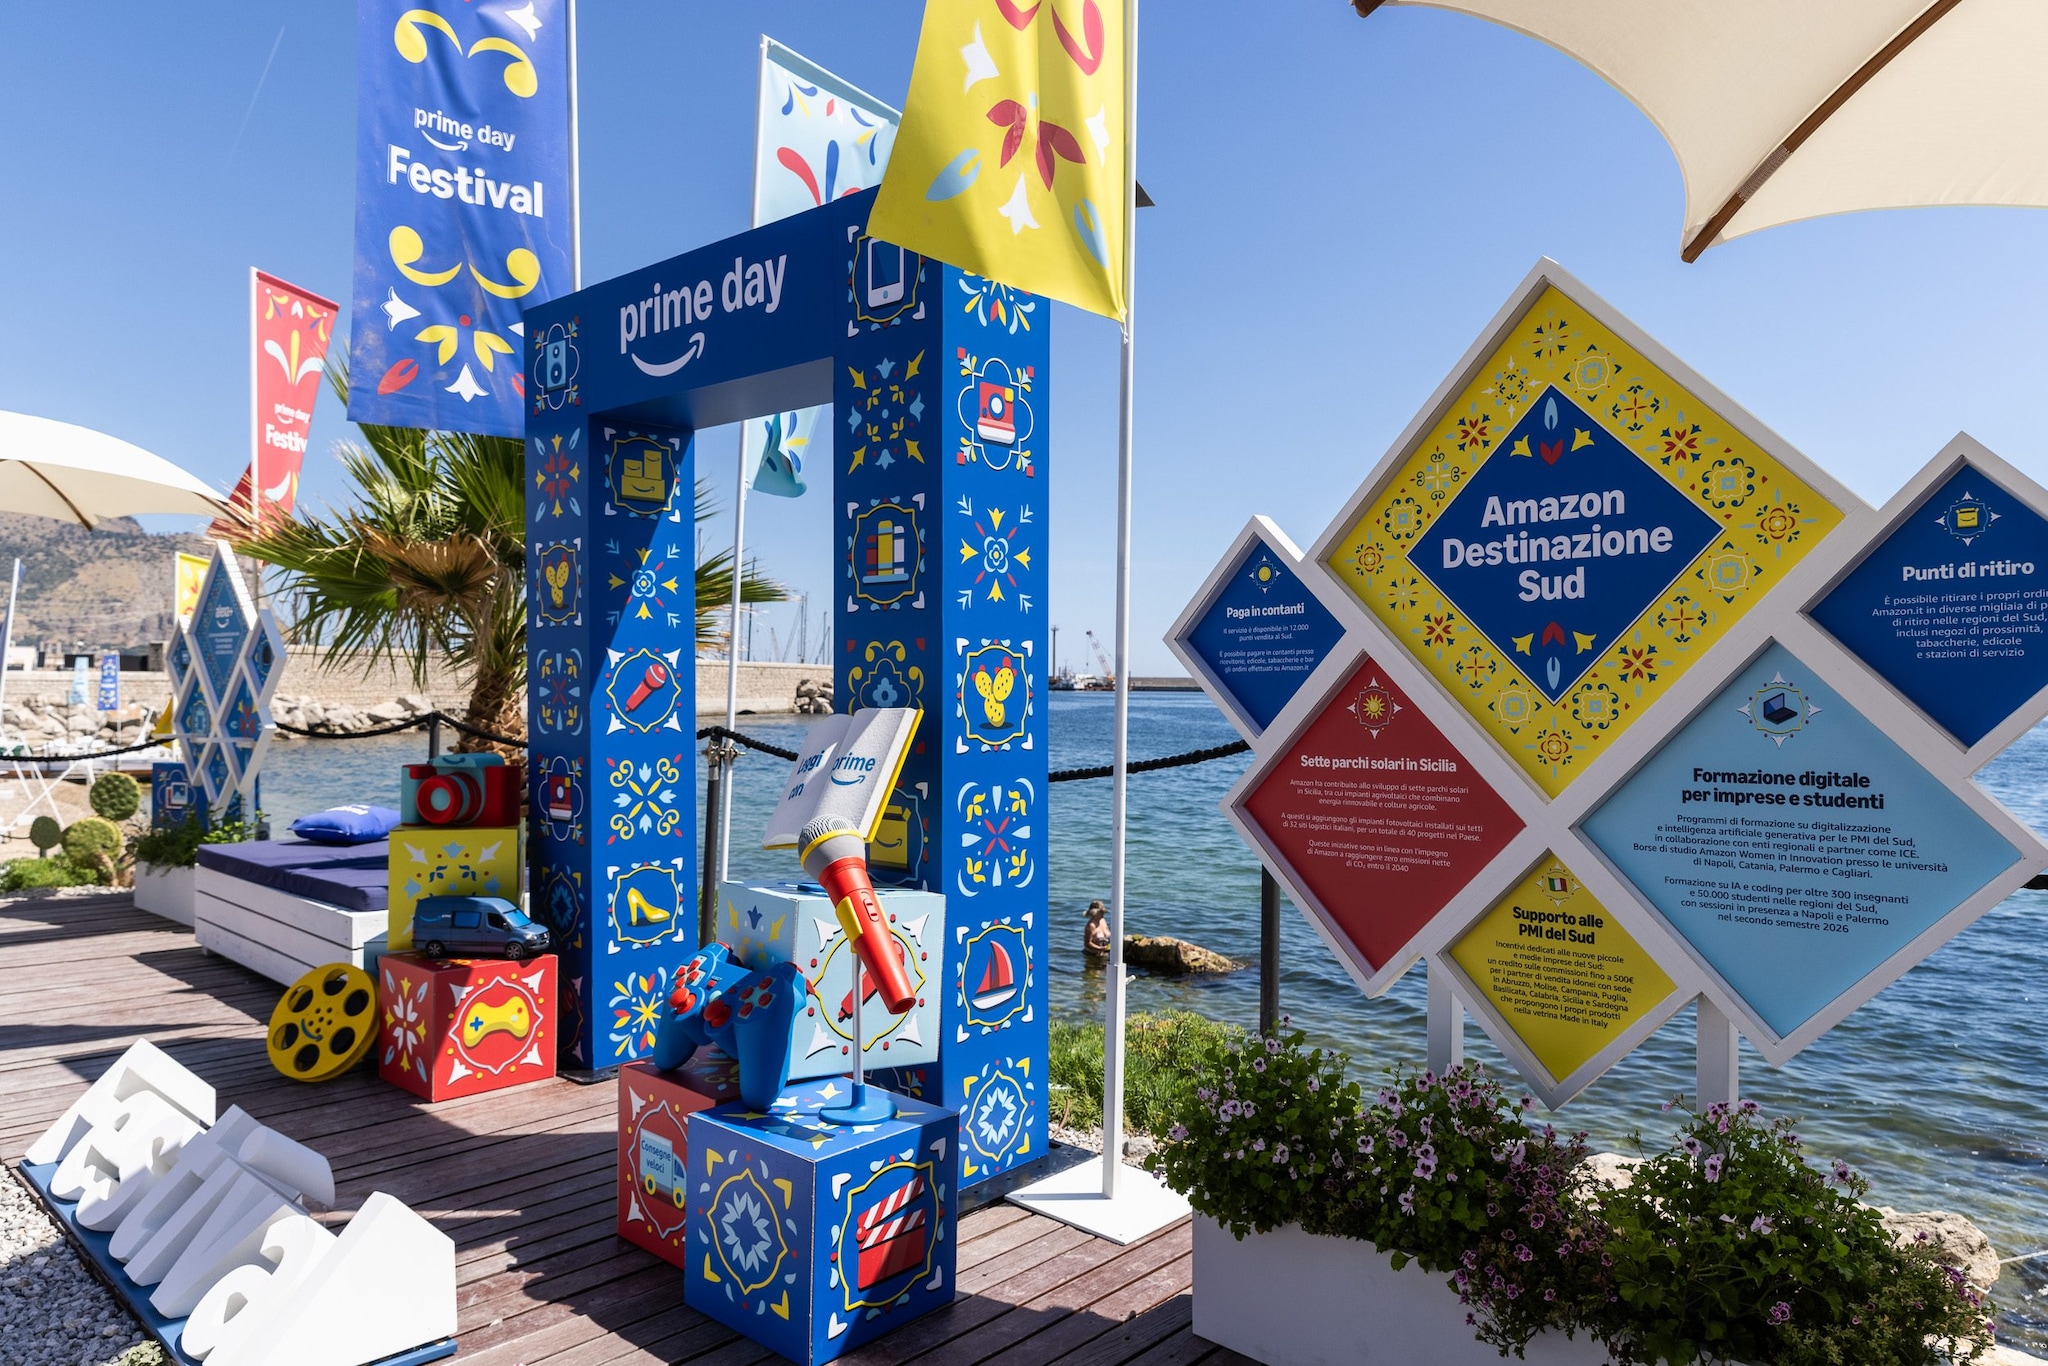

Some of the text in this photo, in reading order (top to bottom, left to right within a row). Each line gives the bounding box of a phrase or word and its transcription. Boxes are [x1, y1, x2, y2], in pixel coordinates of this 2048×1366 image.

[414, 108, 516, 152] prime day
[387, 144, 544, 218] Festival
[620, 255, 787, 355] prime day
[274, 403, 310, 423] prime day
[1481, 490, 1625, 527] Amazon
[1443, 524, 1673, 568] Destinazione
[1902, 561, 2034, 581] Punti di ritiro
[1518, 566, 1585, 602] Sud
[1872, 606, 1923, 616] Amazon.it
[1938, 605, 1977, 613] diverse
[1979, 602, 2023, 613] migliaia
[2026, 601, 2037, 609] di
[1884, 595, 1890, 604] È
[1893, 595, 1938, 606] possibile
[1941, 594, 1977, 602] ritirare
[1980, 592, 1983, 600] i
[1986, 590, 2020, 602] propri
[1226, 602, 1304, 619] Paga in contanti
[1892, 612, 2047, 626] di ritiro nelle regioni del Sud,
[1896, 624, 2043, 637] inclusi negozi di prossimità,
[1916, 637, 2022, 647] tabaccherie, edicole
[1925, 649, 1966, 658] stazioni
[1969, 649, 1979, 657] di
[1982, 648, 2024, 657] servizio
[798, 750, 825, 775] Leggi
[1300, 755, 1457, 772] Sette parchi solari in Sicilia
[1693, 768, 1870, 789] Formazione digitale
[788, 782, 804, 800] con
[1681, 788, 1884, 809] per imprese e studenti
[1677, 814, 1727, 825] Programmi
[1729, 817, 1738, 825] di
[1740, 817, 1796, 828] formazione
[1811, 822, 1891, 833] digitalizzazione
[1664, 824, 1716, 835] intelligenza
[1718, 828, 1762, 837] artificiale
[1764, 832, 1816, 840] generativa
[1838, 834, 1848, 842] le
[1850, 835, 1870, 844] PMI
[1872, 837, 1889, 845] del
[1892, 838, 1916, 848] Sud,
[1665, 835, 1730, 846] collaborazione
[1772, 842, 1815, 852] regionali
[1826, 846, 1866, 854] partner
[1867, 849, 1897, 857] come
[1899, 850, 1920, 858] ICE.
[1633, 843, 1948, 872] Borse di studio Amazon Women in Innovation presso le università
[1692, 857, 1702, 865] di
[1703, 858, 1736, 869] Napoli,
[1738, 861, 1776, 872] Catania,
[1779, 864, 1820, 874] Palermo
[1831, 868, 1873, 878] Cagliari.
[1664, 876, 1716, 888] Formazione
[1731, 882, 1741, 890] IA
[1751, 884, 1784, 895] coding
[1786, 888, 1802, 896] per
[1804, 888, 1828, 897] oltre
[1831, 890, 1851, 899] 300
[1853, 892, 1909, 904] insegnanti
[1697, 890, 1729, 899] 50.000
[1731, 893, 1770, 903] studenti
[1772, 897, 1796, 905] nelle
[1799, 900, 1834, 909] regioni
[1836, 902, 1852, 910] del
[1855, 903, 1878, 914] Sud,
[1512, 906, 1604, 928] Supporto alle
[1699, 902, 1734, 910] sessioni
[1747, 906, 1790, 917] presenza
[1801, 910, 1834, 920] Napoli
[1845, 914, 1889, 925] Palermo
[1518, 923, 1595, 944] PMI del Sud
[1734, 916, 1774, 925] secondo
[1775, 920, 1820, 930] semestre
[1822, 922, 1849, 933] 2026
[1495, 940, 1525, 950] Incentivi
[1526, 944, 1556, 954] dedicati
[1572, 952, 1596, 960] nuove
[1597, 954, 1624, 963] piccole
[1519, 954, 1542, 962] medie
[1543, 956, 1572, 966] imprese
[1573, 960, 1586, 968] del
[1587, 962, 1604, 970] Sud:
[1532, 1010, 1558, 1019] vetrina
[1559, 1013, 1580, 1023] Made
[1591, 1018, 1608, 1028] Italy
[642, 1140, 671, 1162] Consegne
[647, 1158, 664, 1174] veloci
